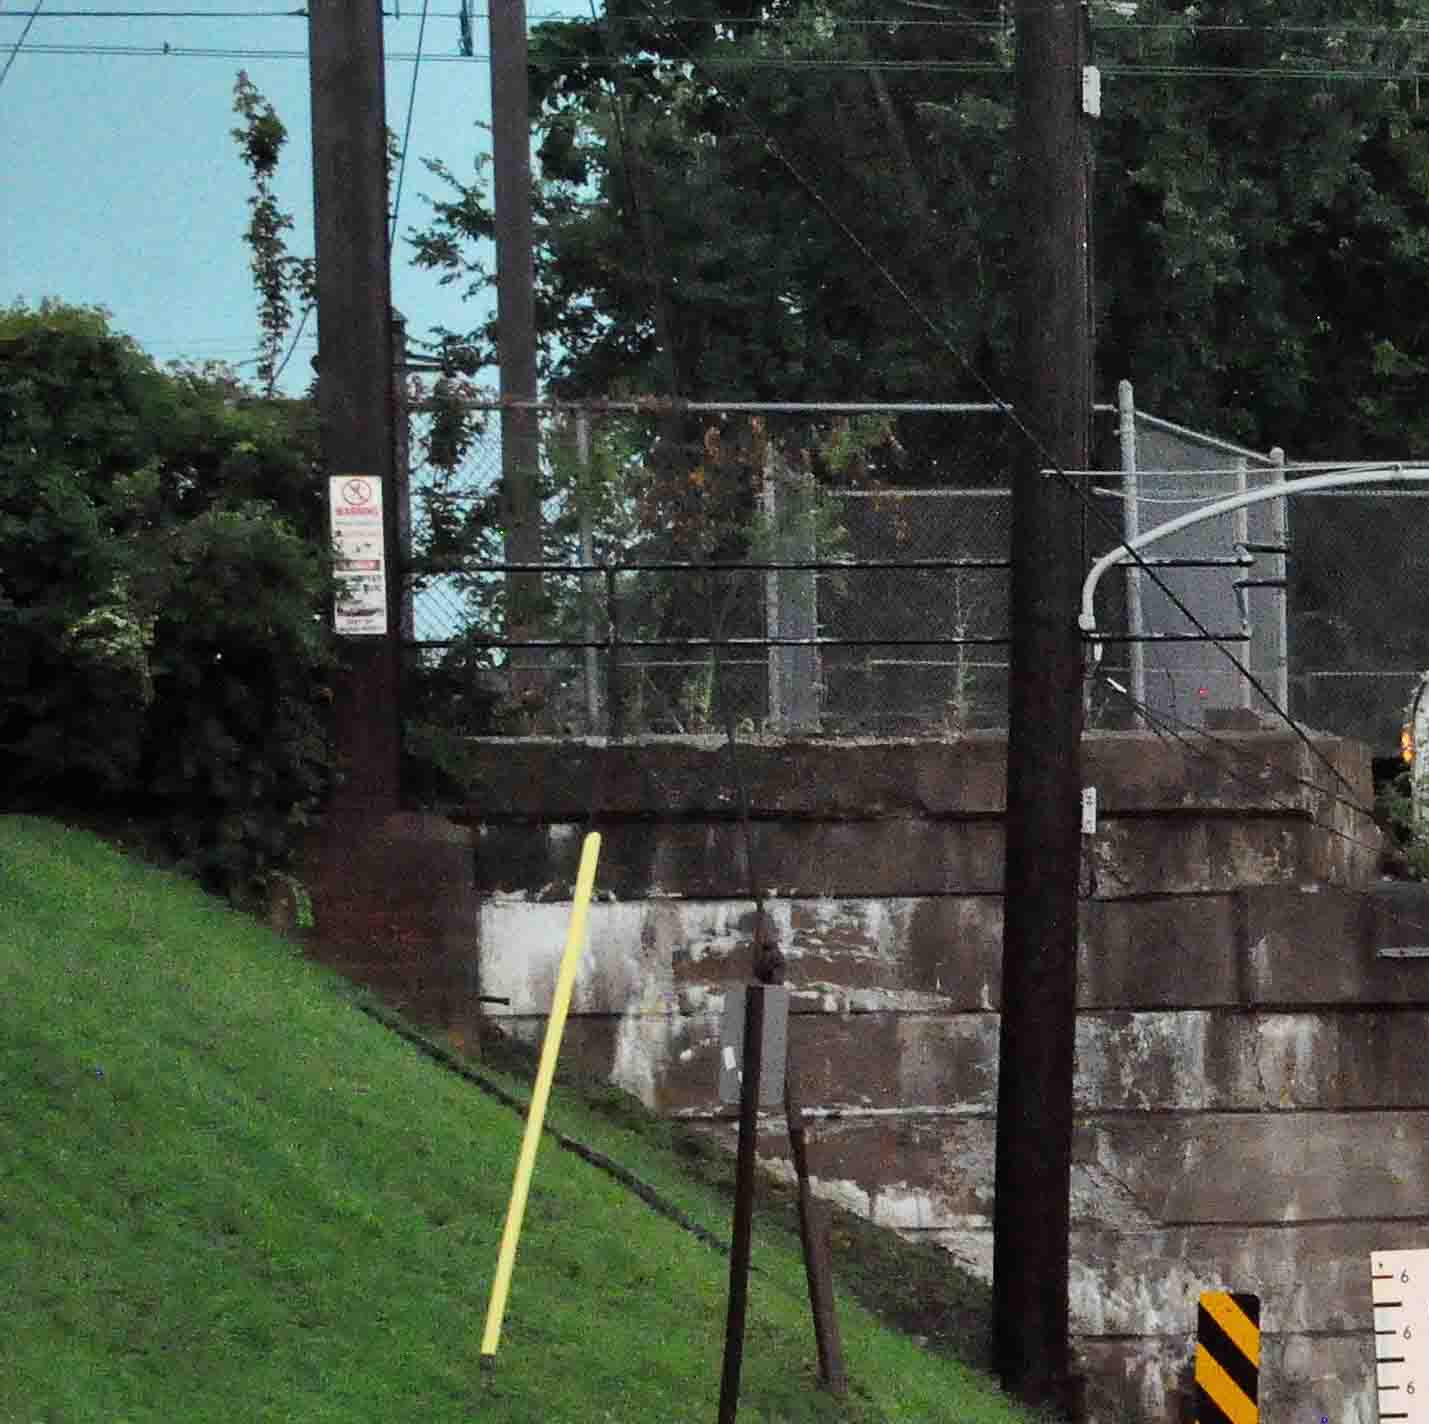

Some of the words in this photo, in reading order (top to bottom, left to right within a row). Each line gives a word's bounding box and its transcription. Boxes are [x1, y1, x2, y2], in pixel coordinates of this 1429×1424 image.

[1399, 1268, 1410, 1284] 6
[1402, 1326, 1413, 1341] 6
[1406, 1380, 1416, 1395] 6
